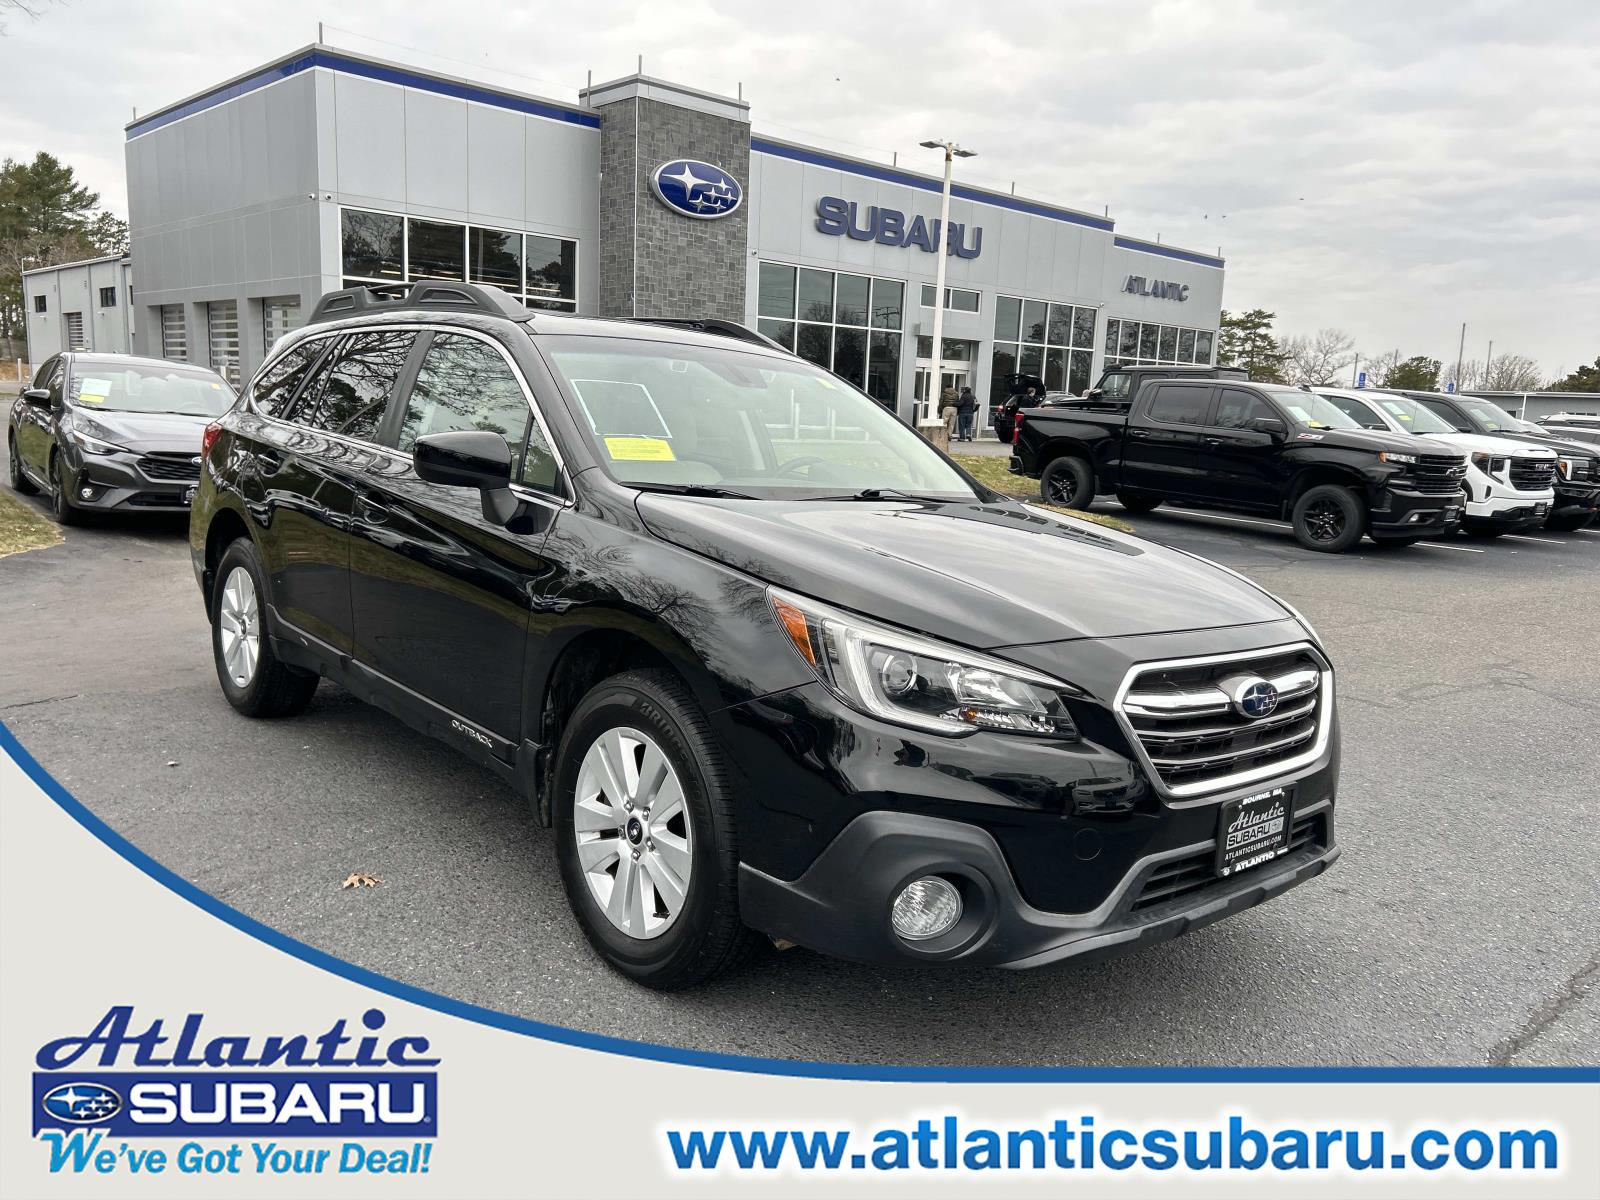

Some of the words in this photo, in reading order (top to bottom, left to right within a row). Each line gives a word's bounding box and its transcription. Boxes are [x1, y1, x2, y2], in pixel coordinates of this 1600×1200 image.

[816, 196, 982, 259] SUBARU
[1121, 275, 1189, 301] ATLANTIC
[452, 719, 493, 748] OUTBACK
[1228, 802, 1284, 833] Atlantic
[1225, 835, 1282, 860] ATLANTICSUBARU.COM
[1228, 823, 1270, 846] SUBARU
[1235, 851, 1275, 872] ATLANTIC
